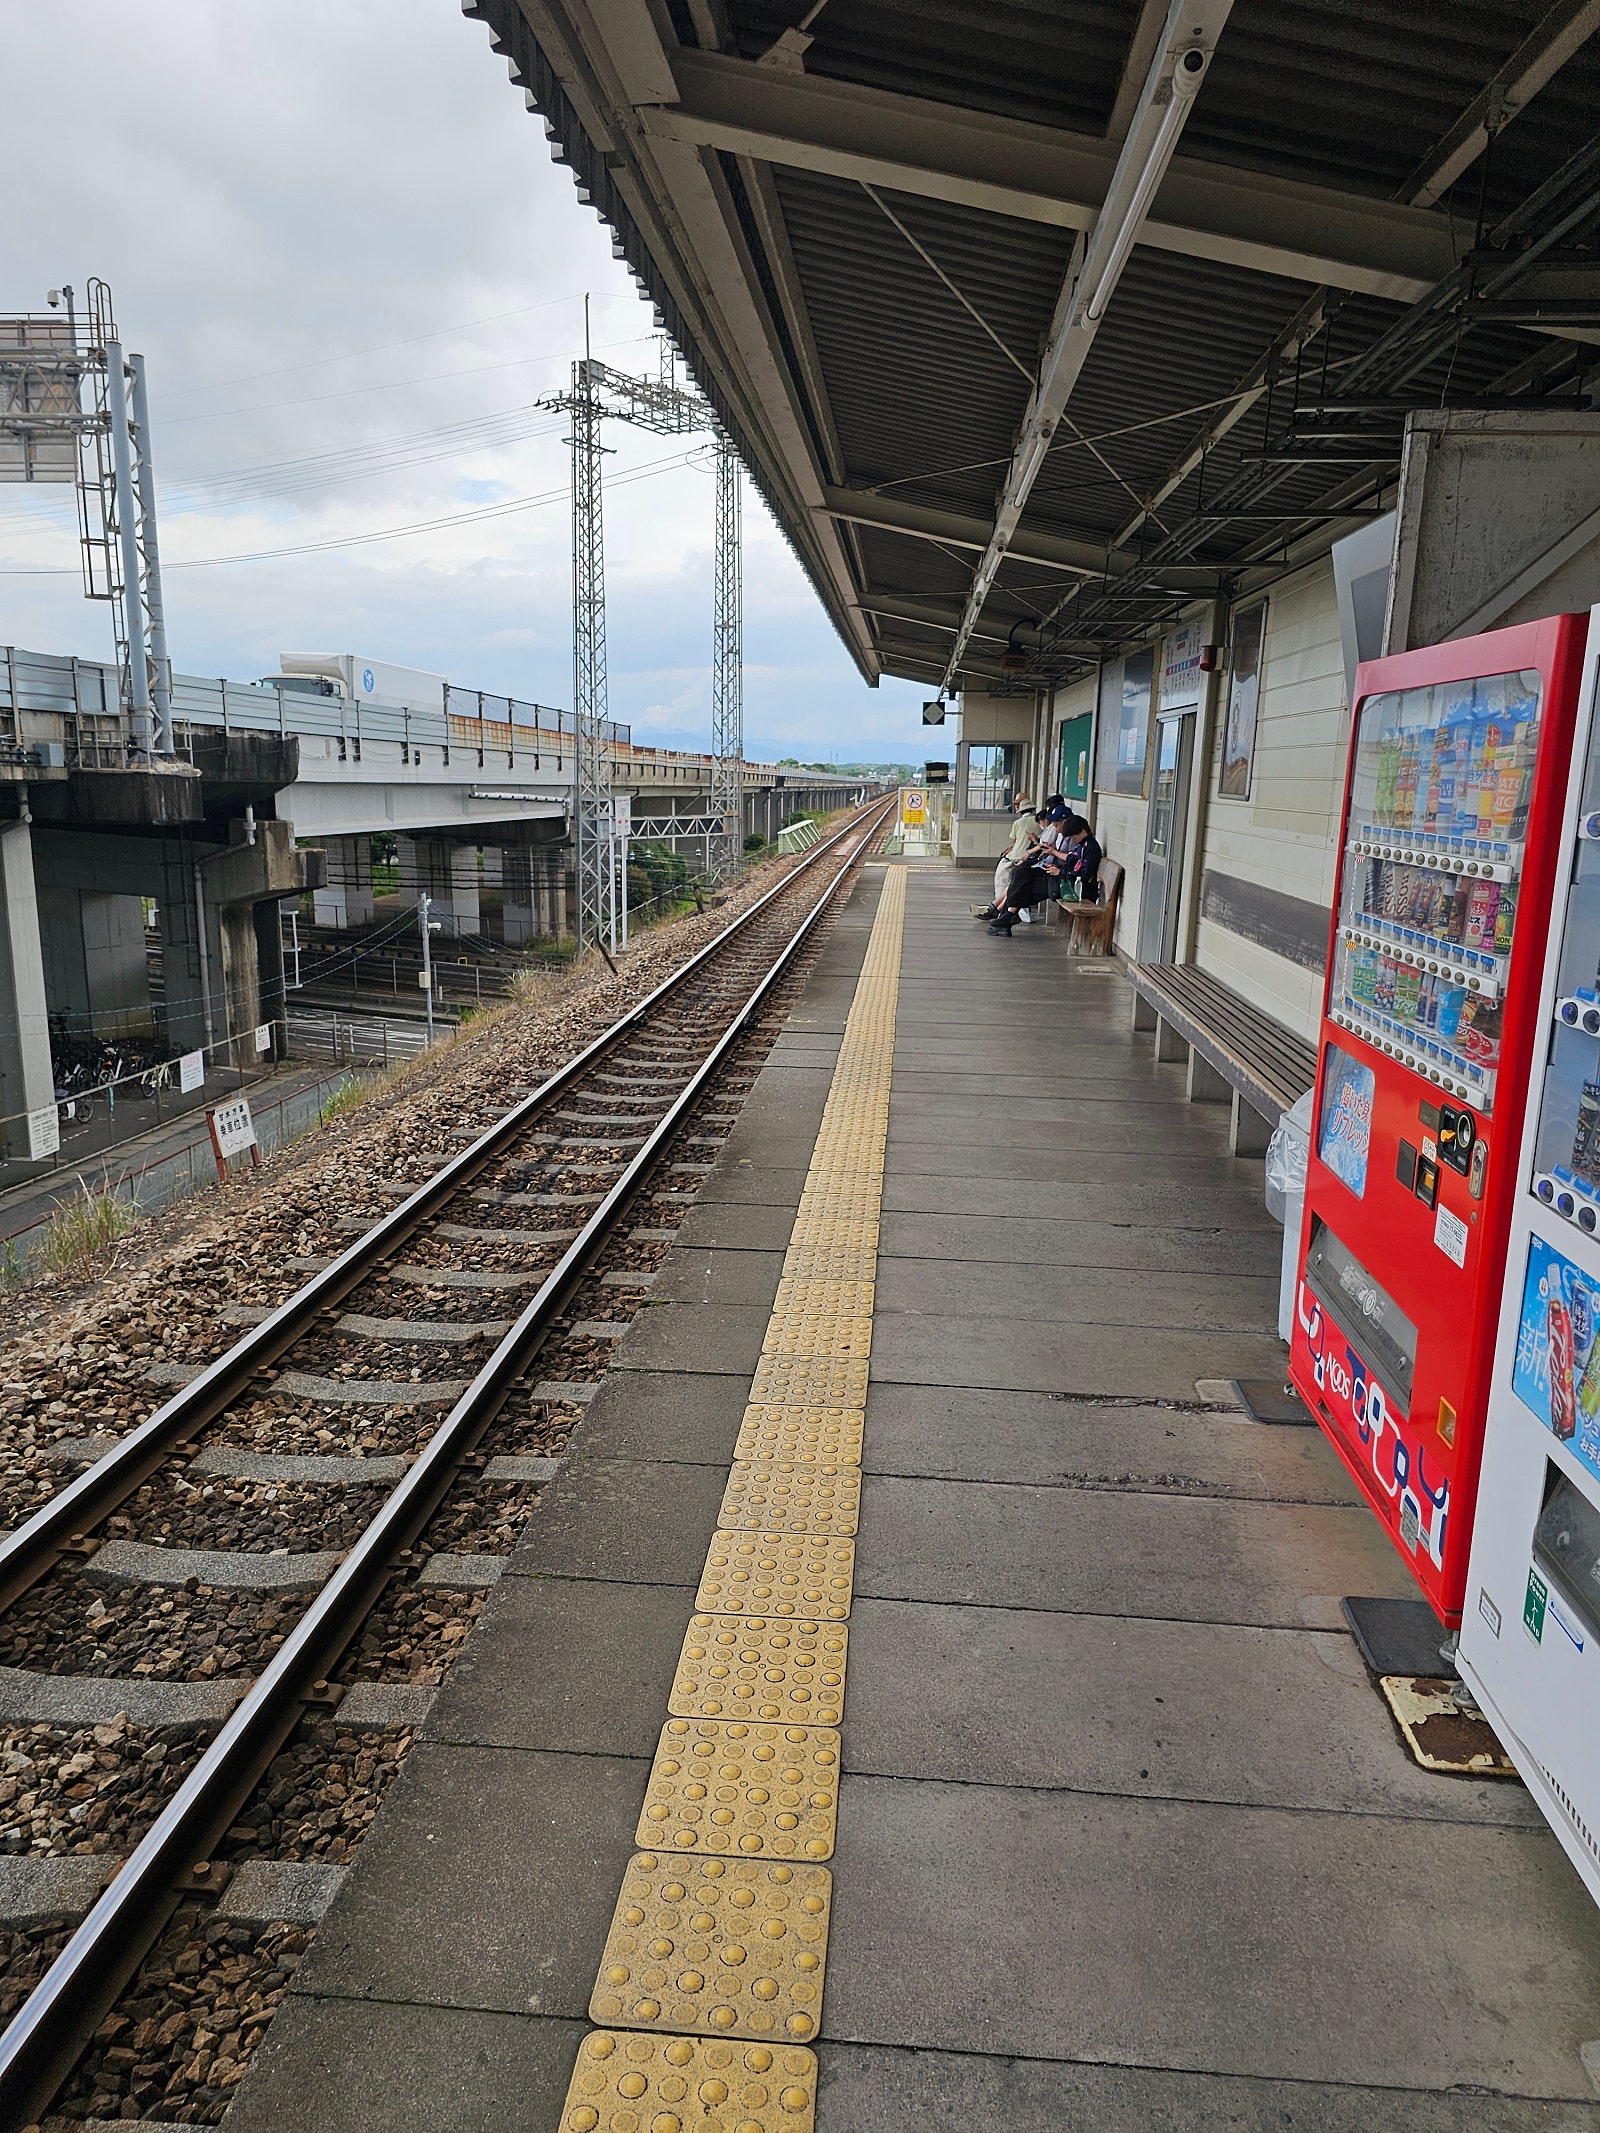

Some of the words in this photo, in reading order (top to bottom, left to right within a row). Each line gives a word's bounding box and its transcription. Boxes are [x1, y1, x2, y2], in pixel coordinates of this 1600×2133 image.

[1384, 873, 1396, 914] BOSS
[1396, 873, 1410, 916] BOSS
[220, 1114, 249, 1137] 乗車位置
[1529, 1579, 1545, 1604] Power
[1530, 1572, 1545, 1596] Green
